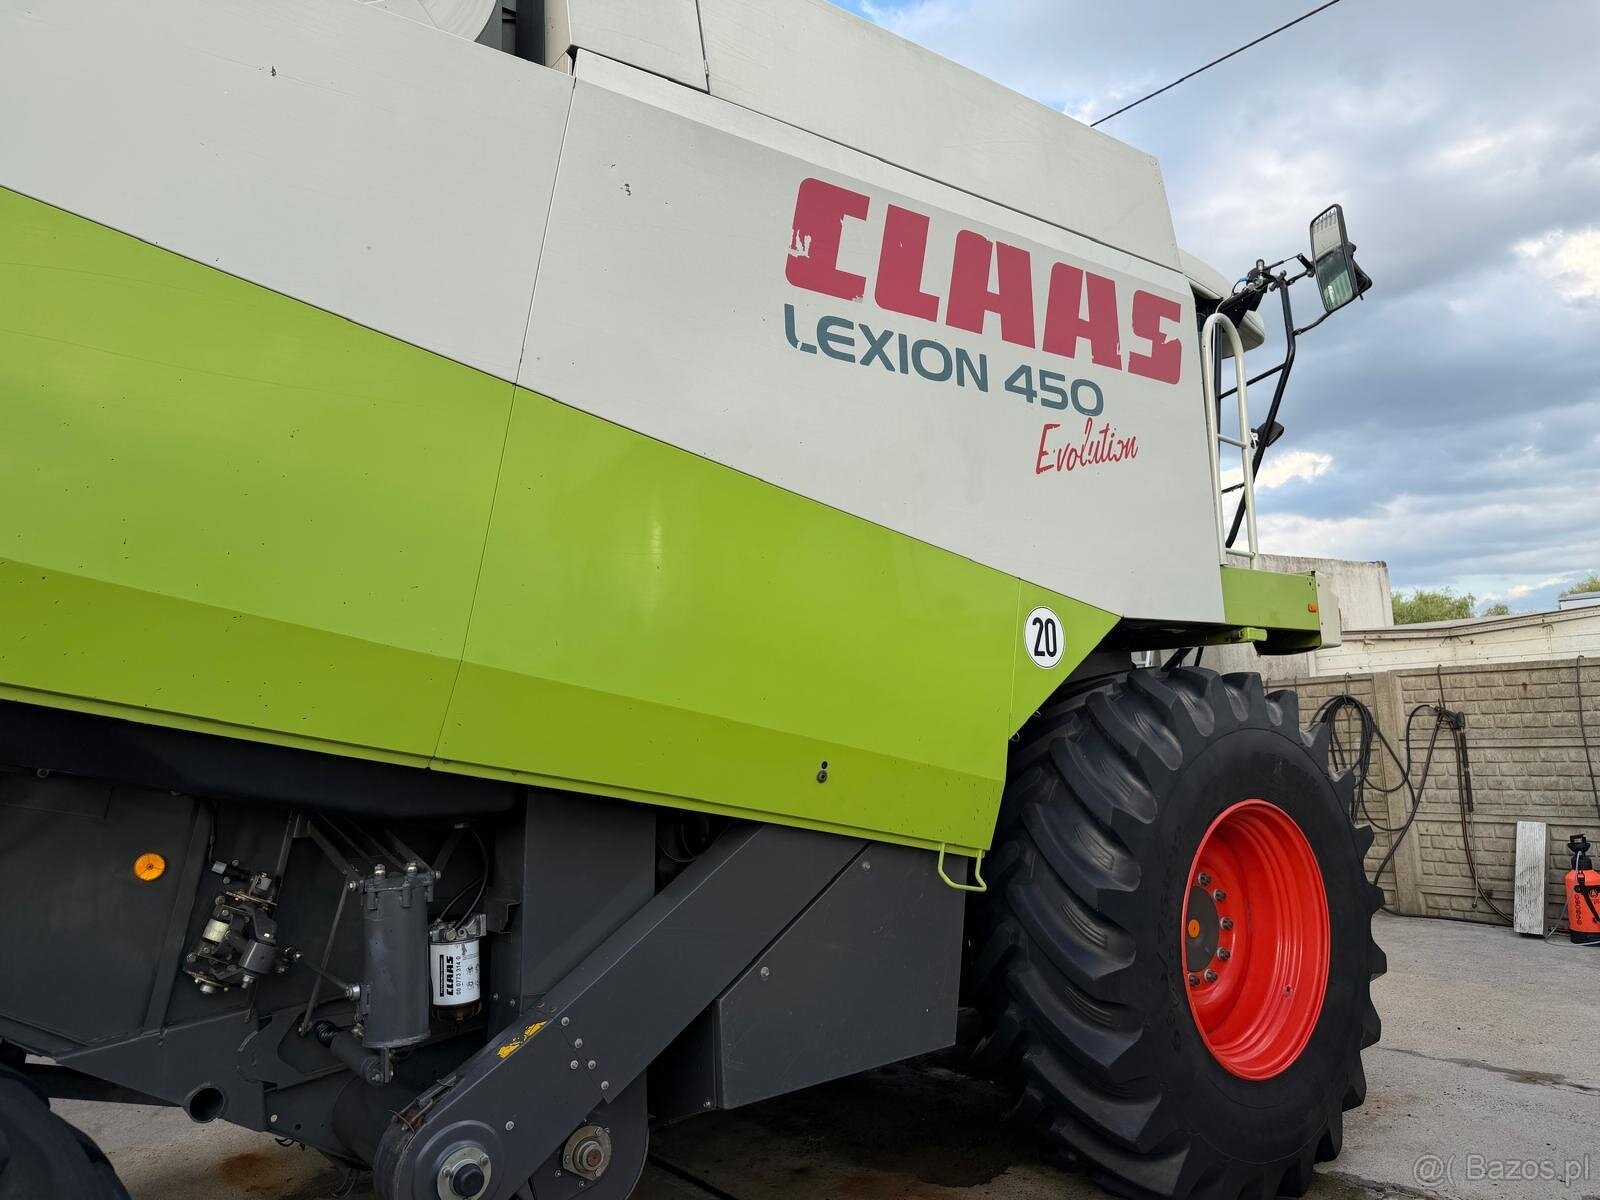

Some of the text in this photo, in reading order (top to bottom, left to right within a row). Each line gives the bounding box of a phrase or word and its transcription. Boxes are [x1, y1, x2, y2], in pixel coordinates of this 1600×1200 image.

[785, 177, 1182, 385] CLAAS
[784, 303, 1104, 417] LEXION 450
[1035, 417, 1139, 475] Evolution
[1032, 617, 1057, 657] 20
